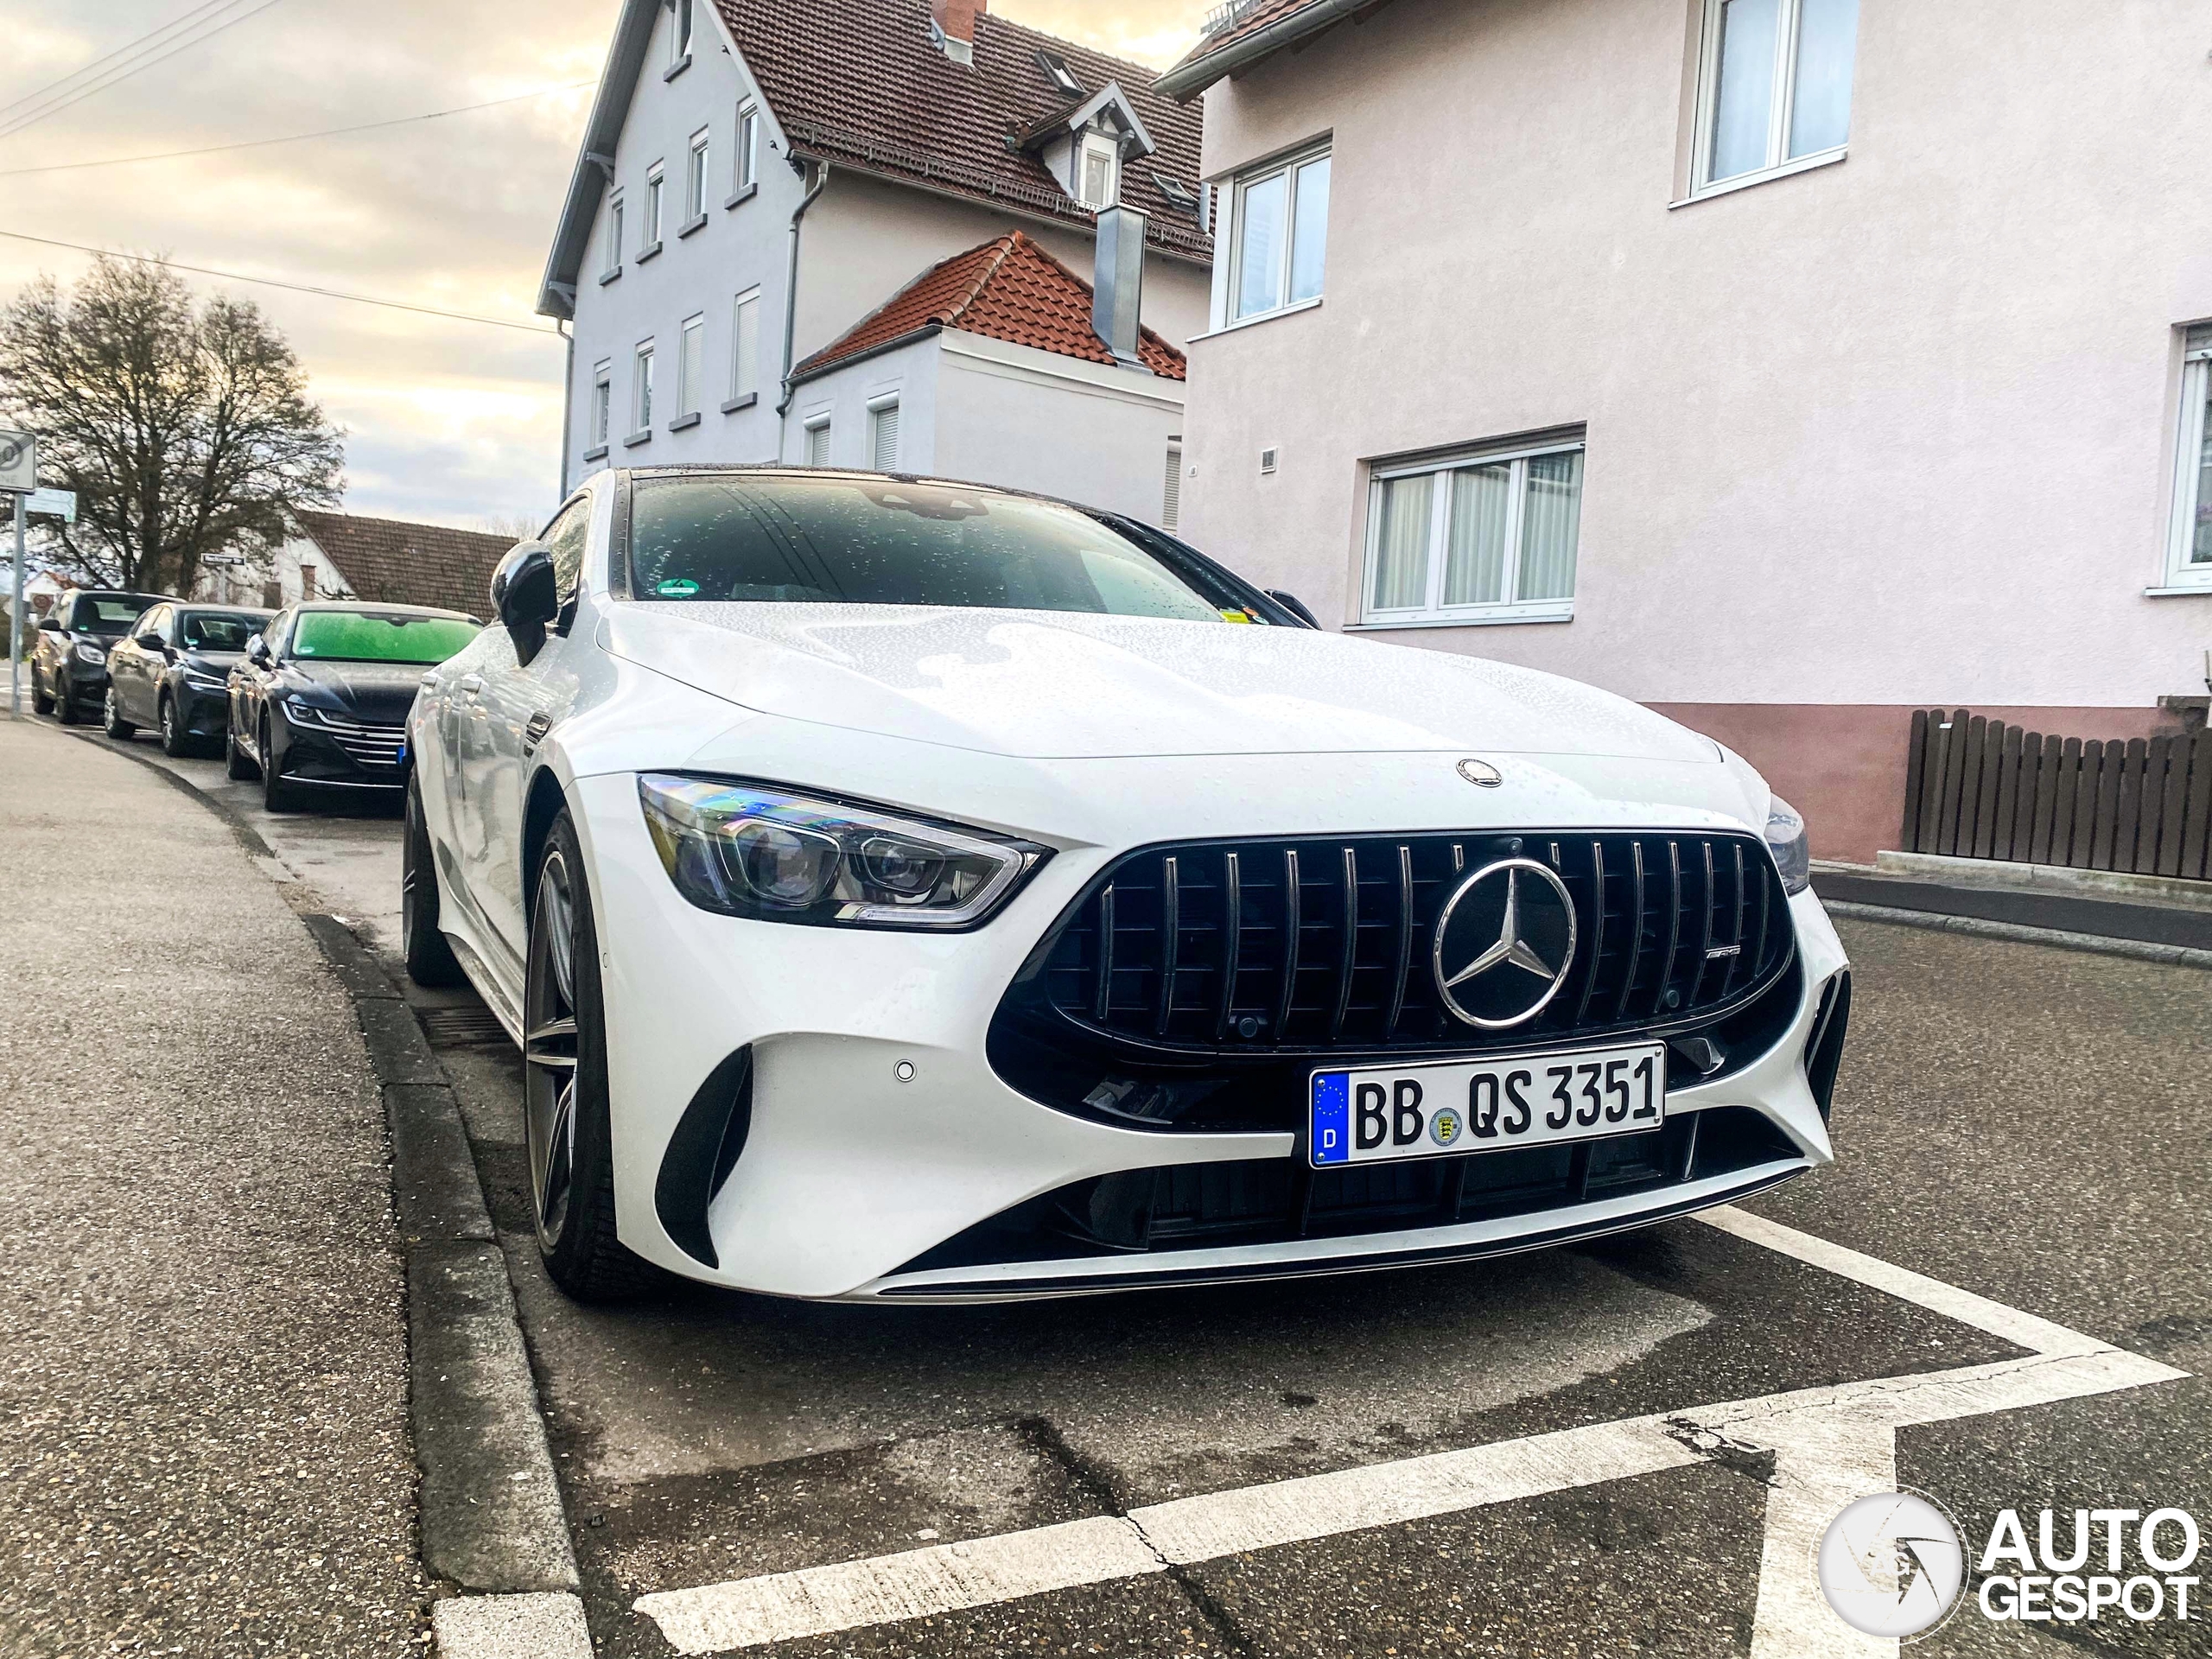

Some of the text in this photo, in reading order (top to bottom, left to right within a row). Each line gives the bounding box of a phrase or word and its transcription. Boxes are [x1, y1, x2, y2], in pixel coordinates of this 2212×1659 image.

[1355, 1078, 1425, 1150] BB
[1468, 1070, 1533, 1139] QS
[1546, 1056, 1658, 1130] 3351
[1323, 1128, 1337, 1148] D
